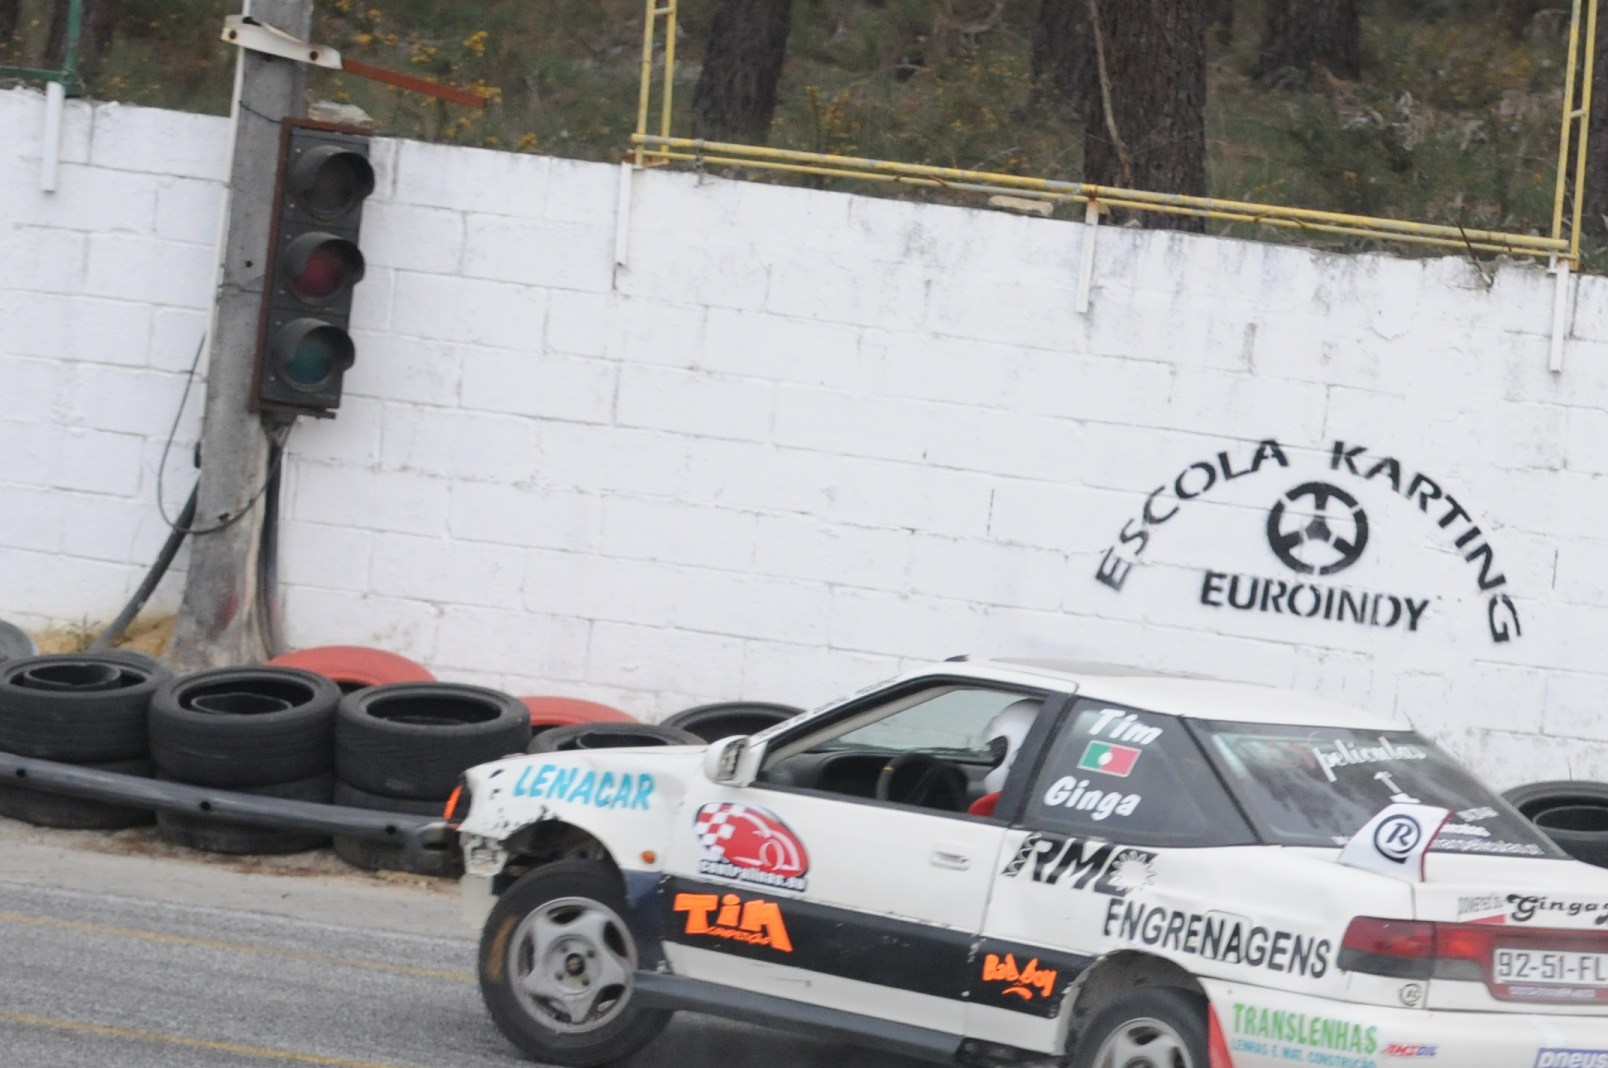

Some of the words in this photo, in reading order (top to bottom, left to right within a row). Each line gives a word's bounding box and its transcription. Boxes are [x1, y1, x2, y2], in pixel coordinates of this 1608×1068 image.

[1096, 439, 1288, 592] ESCOLA
[1331, 441, 1521, 643] KARTING
[1200, 572, 1429, 632] EUROINDY
[1088, 708, 1163, 745] Tim
[514, 764, 656, 811] LENACAR
[1043, 776, 1142, 821] Ginga
[1506, 894, 1597, 922] Ginga
[1103, 898, 1331, 979] ENGRENAGENS
[1499, 951, 1608, 982] 92-51-FL
[1233, 1003, 1378, 1055] TRANSLENHAS
